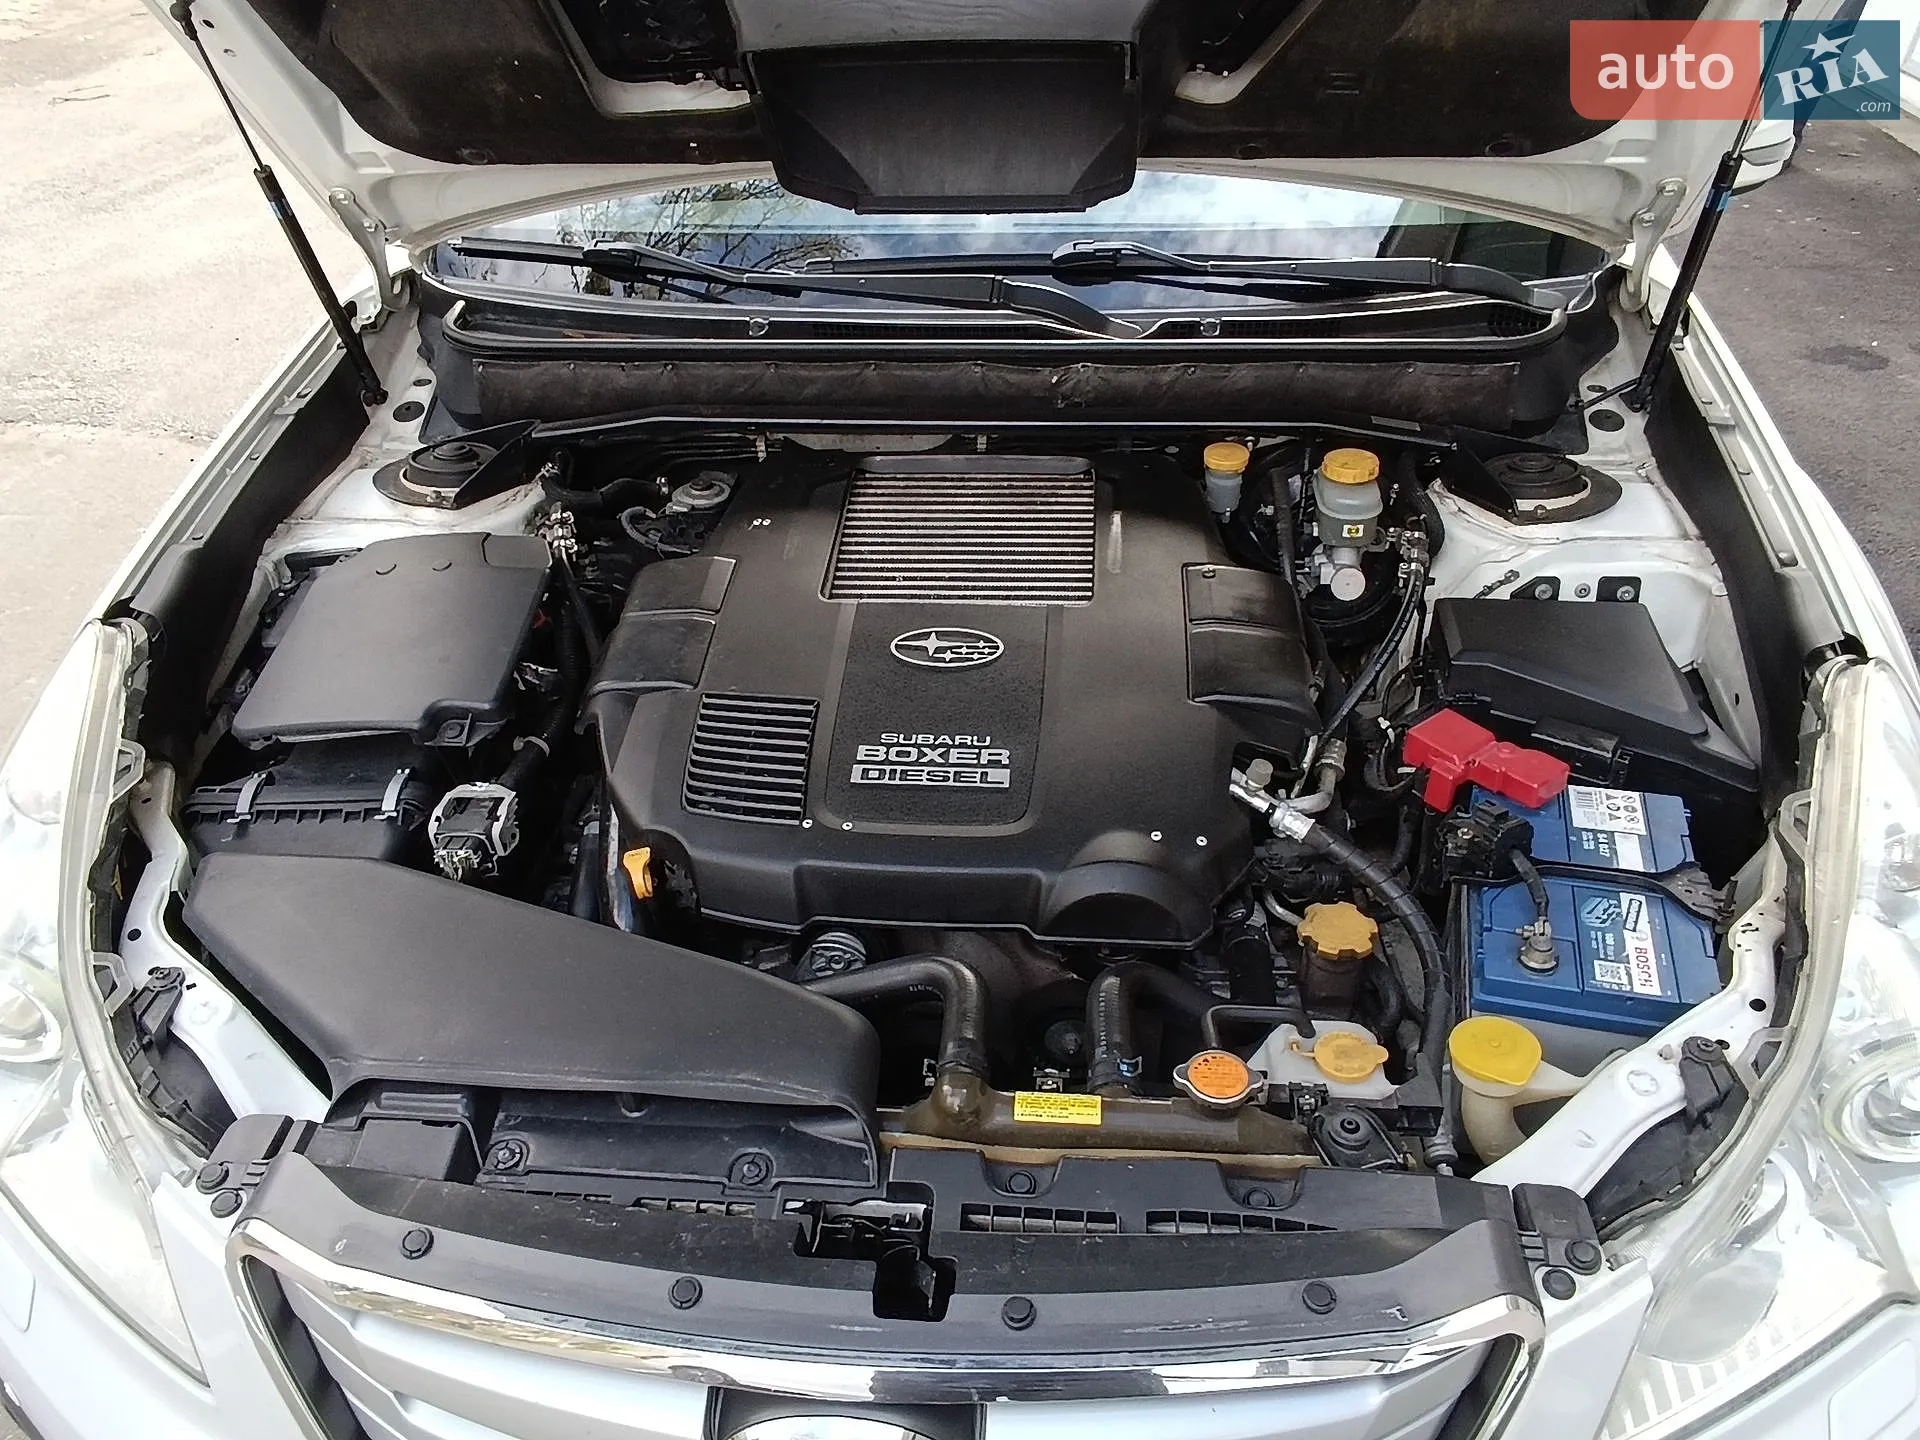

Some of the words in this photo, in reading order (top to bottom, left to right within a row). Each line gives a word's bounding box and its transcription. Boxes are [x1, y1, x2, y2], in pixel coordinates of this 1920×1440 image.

[880, 733, 991, 746] SUBARU
[856, 744, 1011, 765] BOXER
[860, 767, 1005, 785] DIESEL
[1634, 946, 1654, 988] BOSCH
